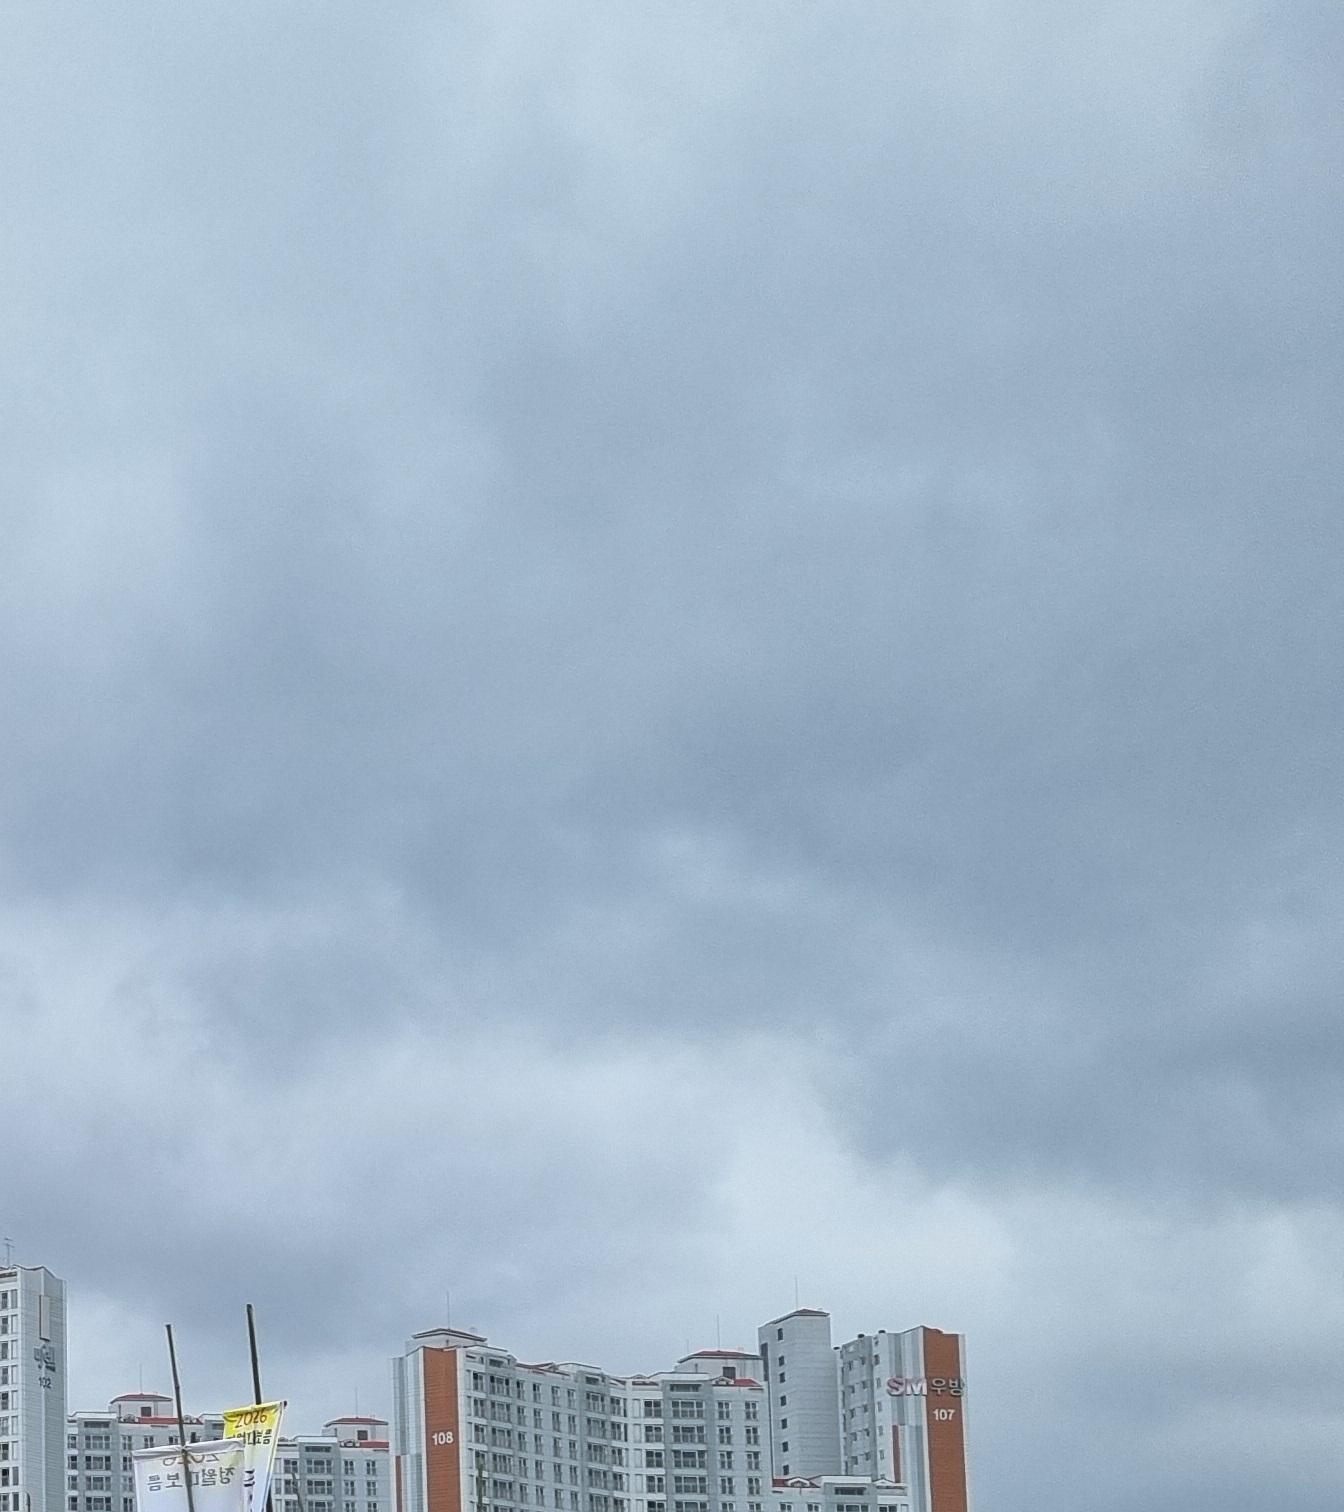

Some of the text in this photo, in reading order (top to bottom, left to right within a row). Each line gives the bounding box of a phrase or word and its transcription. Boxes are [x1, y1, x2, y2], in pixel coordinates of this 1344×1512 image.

[233, 1408, 268, 1429] 2026
[932, 1408, 956, 1421] 107
[431, 1431, 454, 1446] 108
